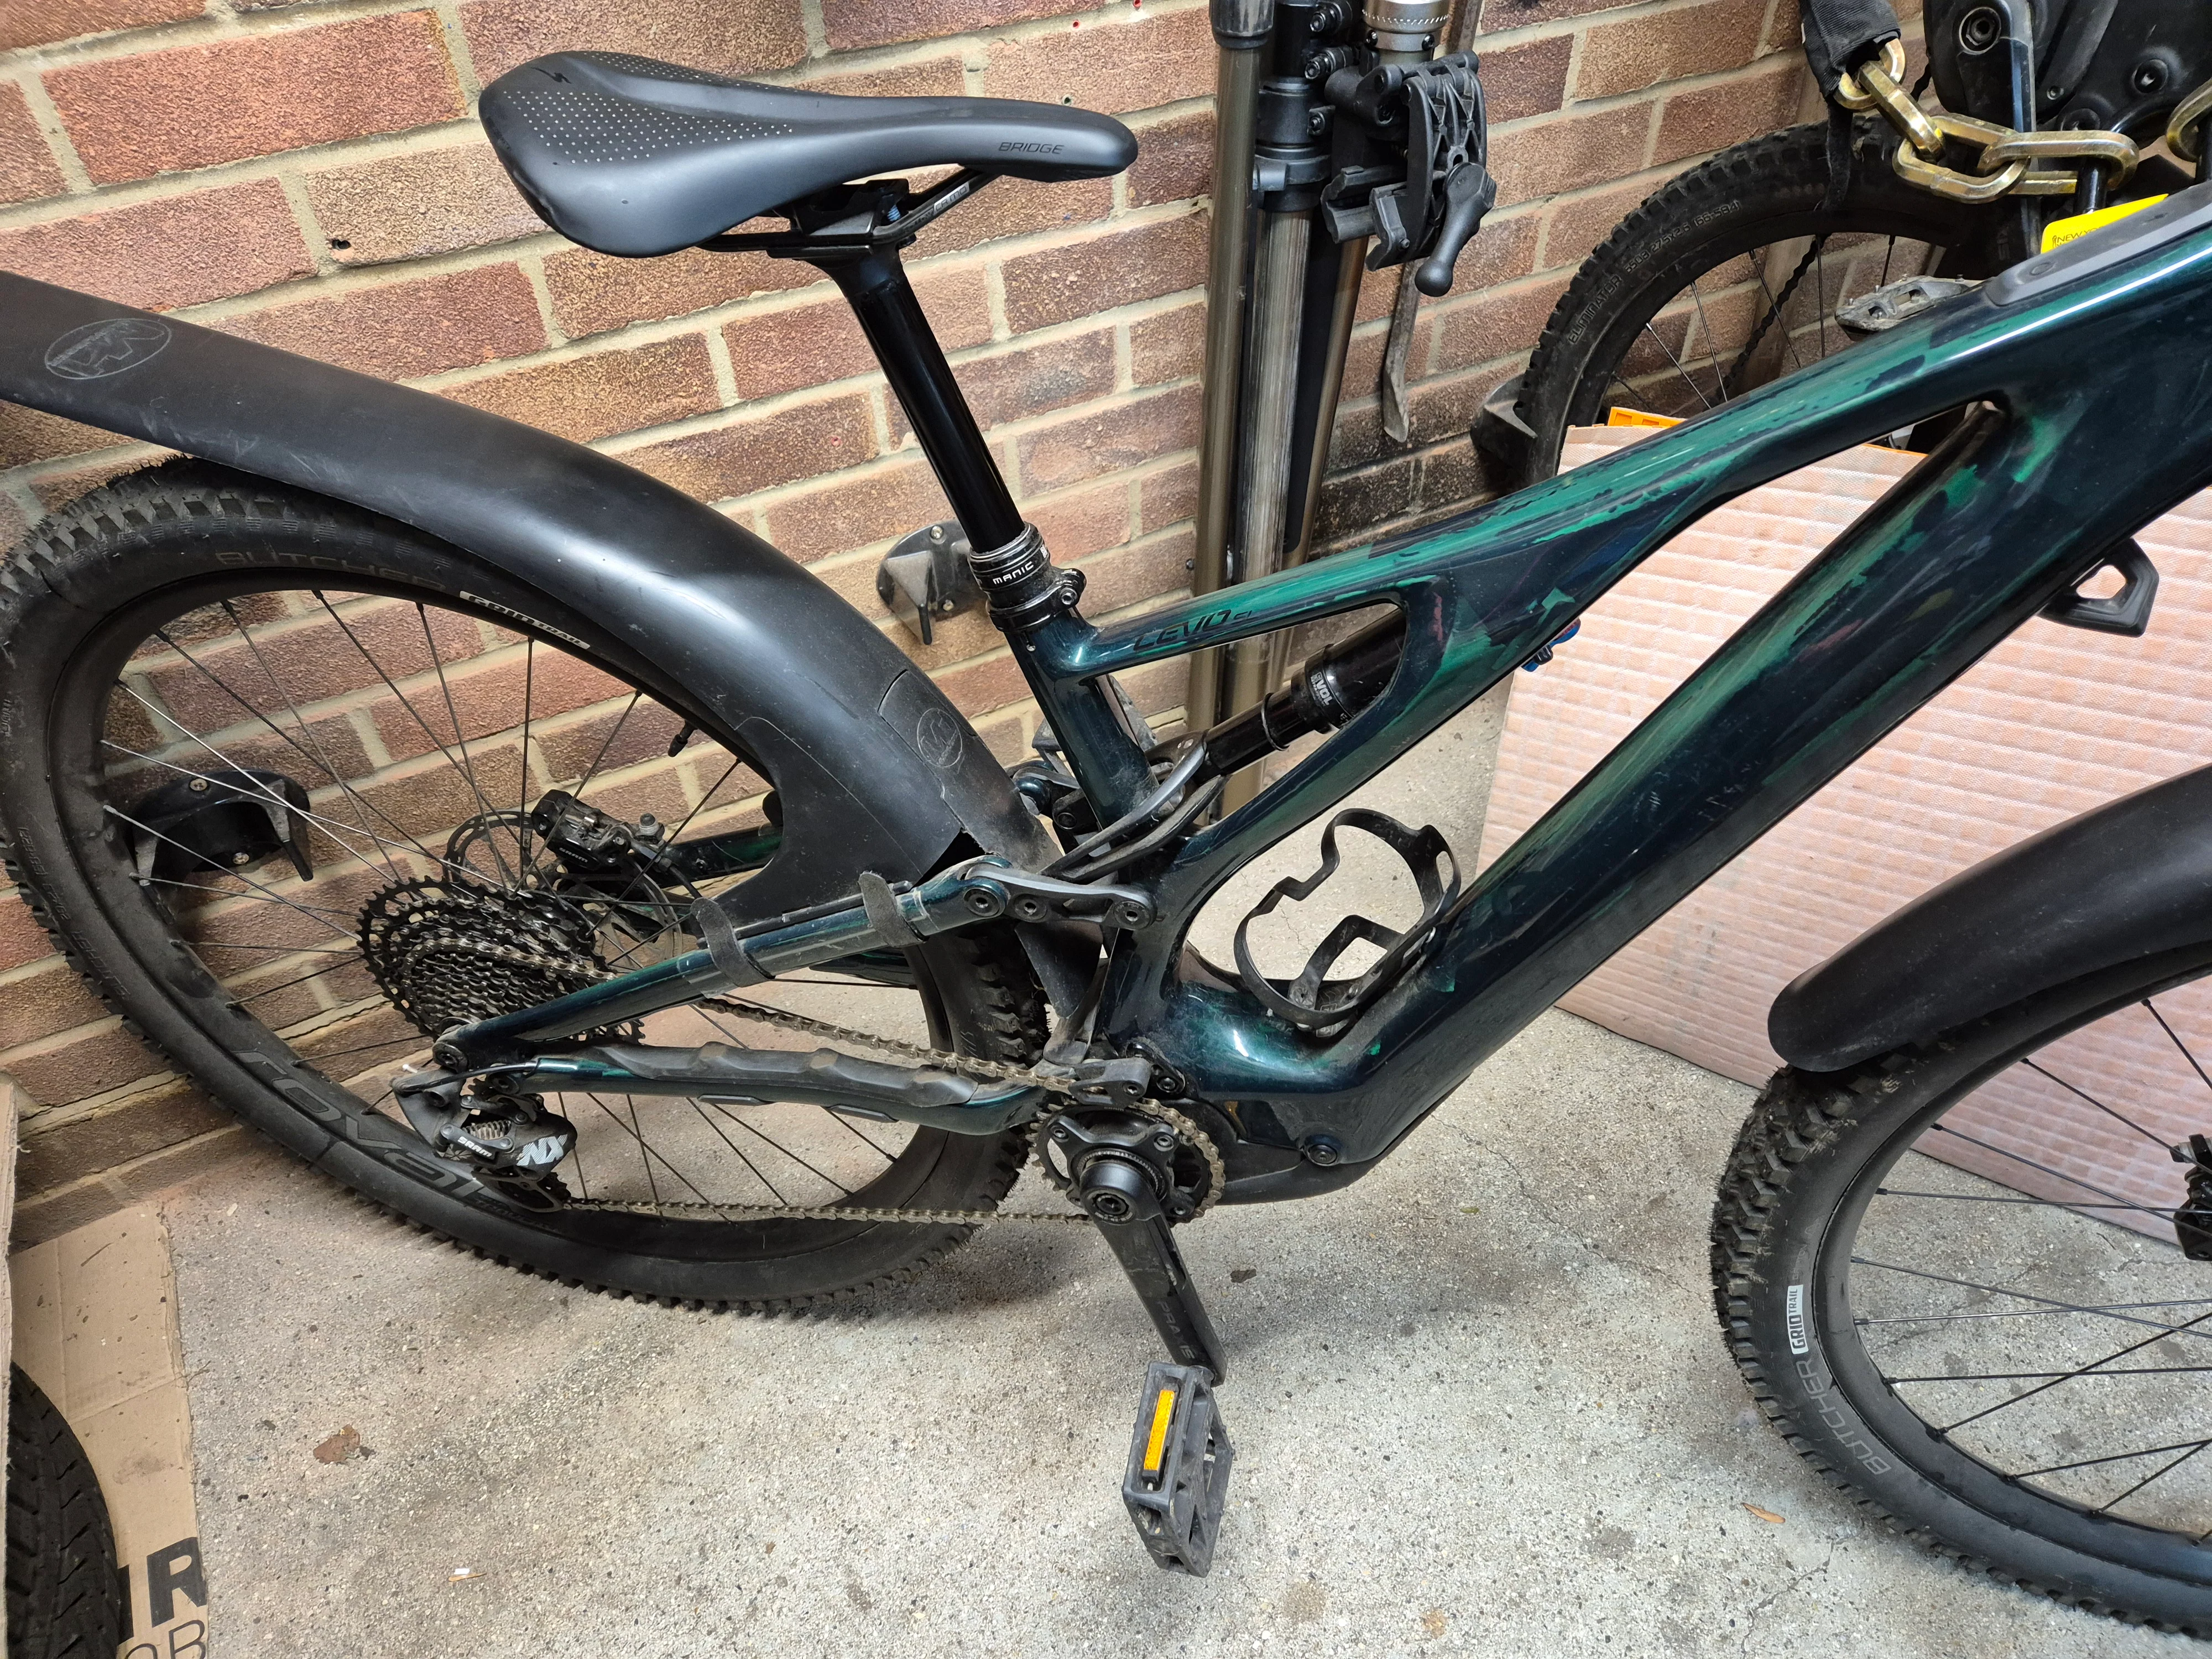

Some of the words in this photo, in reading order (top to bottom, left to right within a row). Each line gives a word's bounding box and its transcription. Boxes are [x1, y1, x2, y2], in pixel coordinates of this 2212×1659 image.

[999, 142, 1065, 154] BRIDGE
[538, 622, 582, 645] TRAIL
[1134, 609, 1232, 651] LEVO
[457, 1136, 493, 1158] SRAM
[515, 1134, 568, 1167] NX
[1788, 1287, 1798, 1314] TRAIL
[1788, 1314, 1807, 1349] GRID
[1796, 1358, 1892, 1475] BUTCHER
